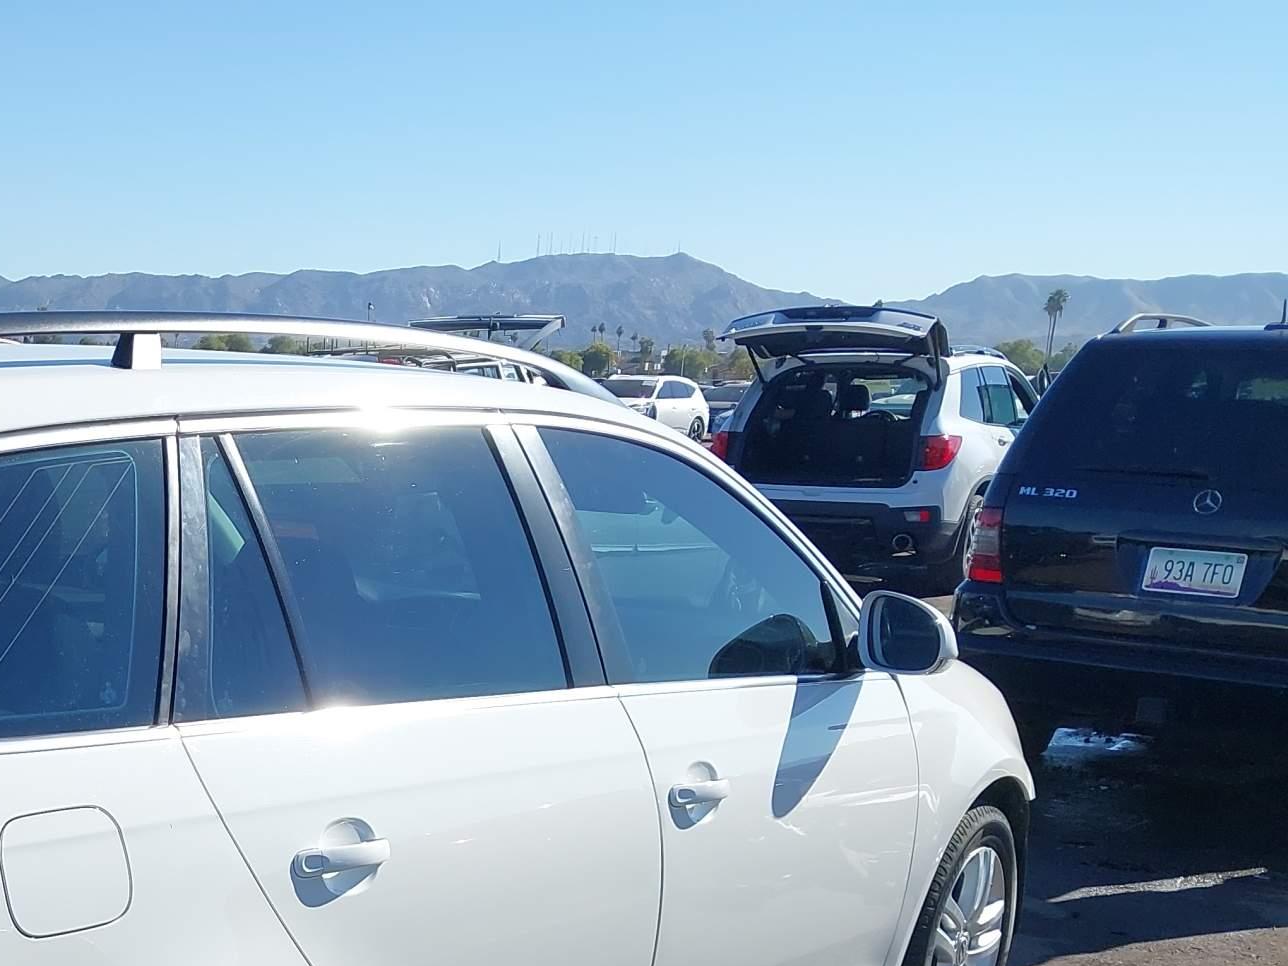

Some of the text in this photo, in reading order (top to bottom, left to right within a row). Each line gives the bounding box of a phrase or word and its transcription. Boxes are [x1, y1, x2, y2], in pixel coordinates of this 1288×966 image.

[1018, 486, 1078, 498] ML 320
[1163, 559, 1195, 583] 93A
